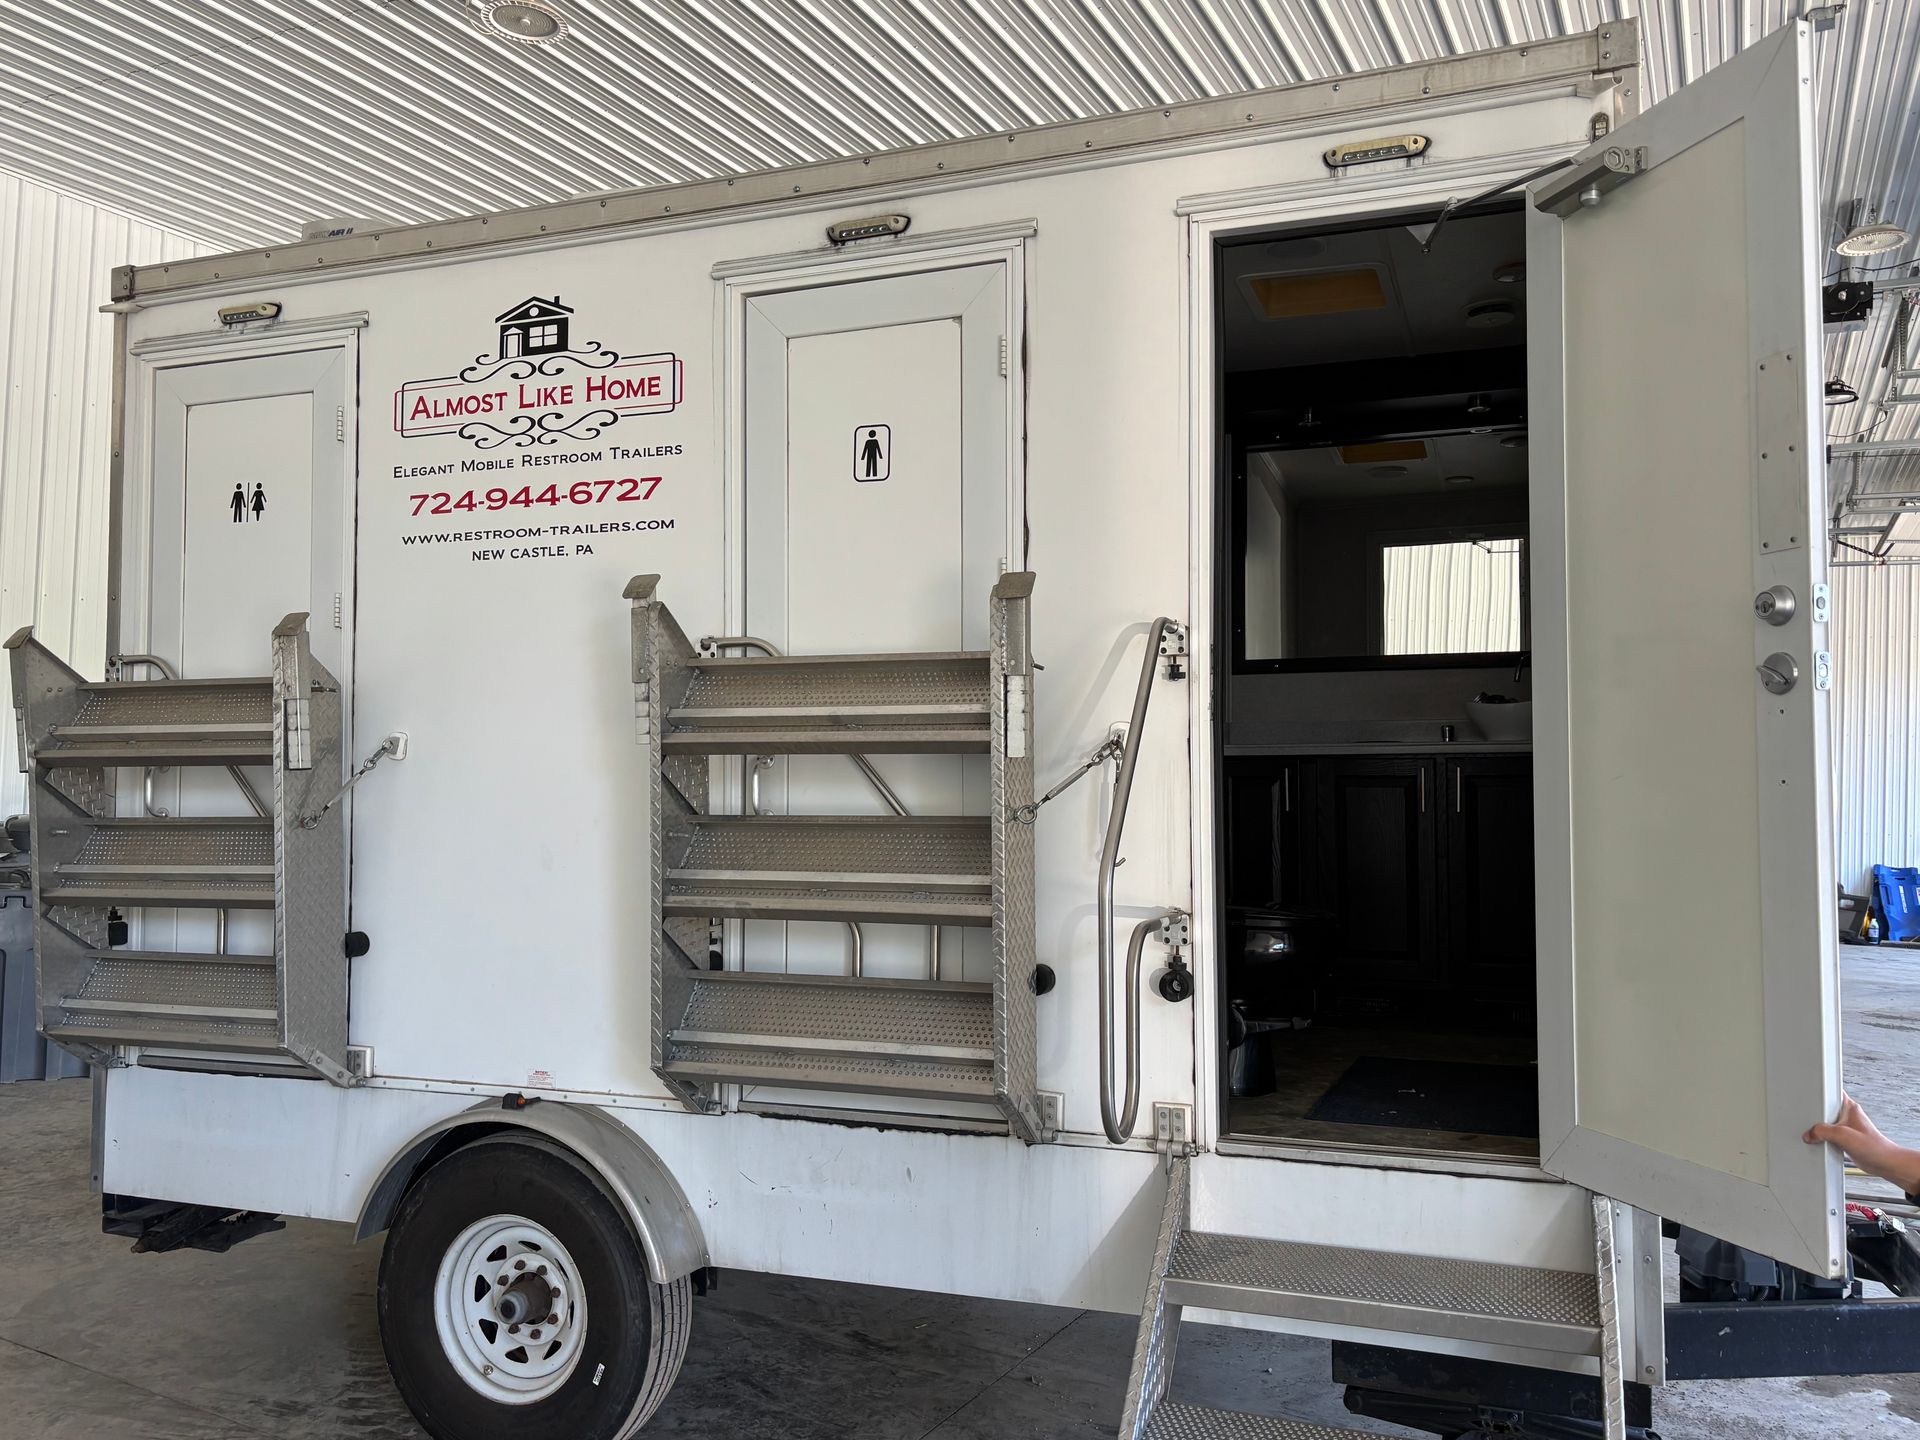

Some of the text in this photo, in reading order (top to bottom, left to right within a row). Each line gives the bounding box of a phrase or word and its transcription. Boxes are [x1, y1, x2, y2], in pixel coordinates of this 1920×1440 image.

[410, 374, 662, 421] ALMOST LIKE HOME
[393, 444, 683, 479] ELEGANT MOBILE RESTROOM TRAILERS
[409, 476, 663, 517] 724-944-6727
[401, 519, 675, 546] WWW.RESTROOM-TRAILERS.COM
[471, 544, 594, 561] NEW CASTLE, PA
